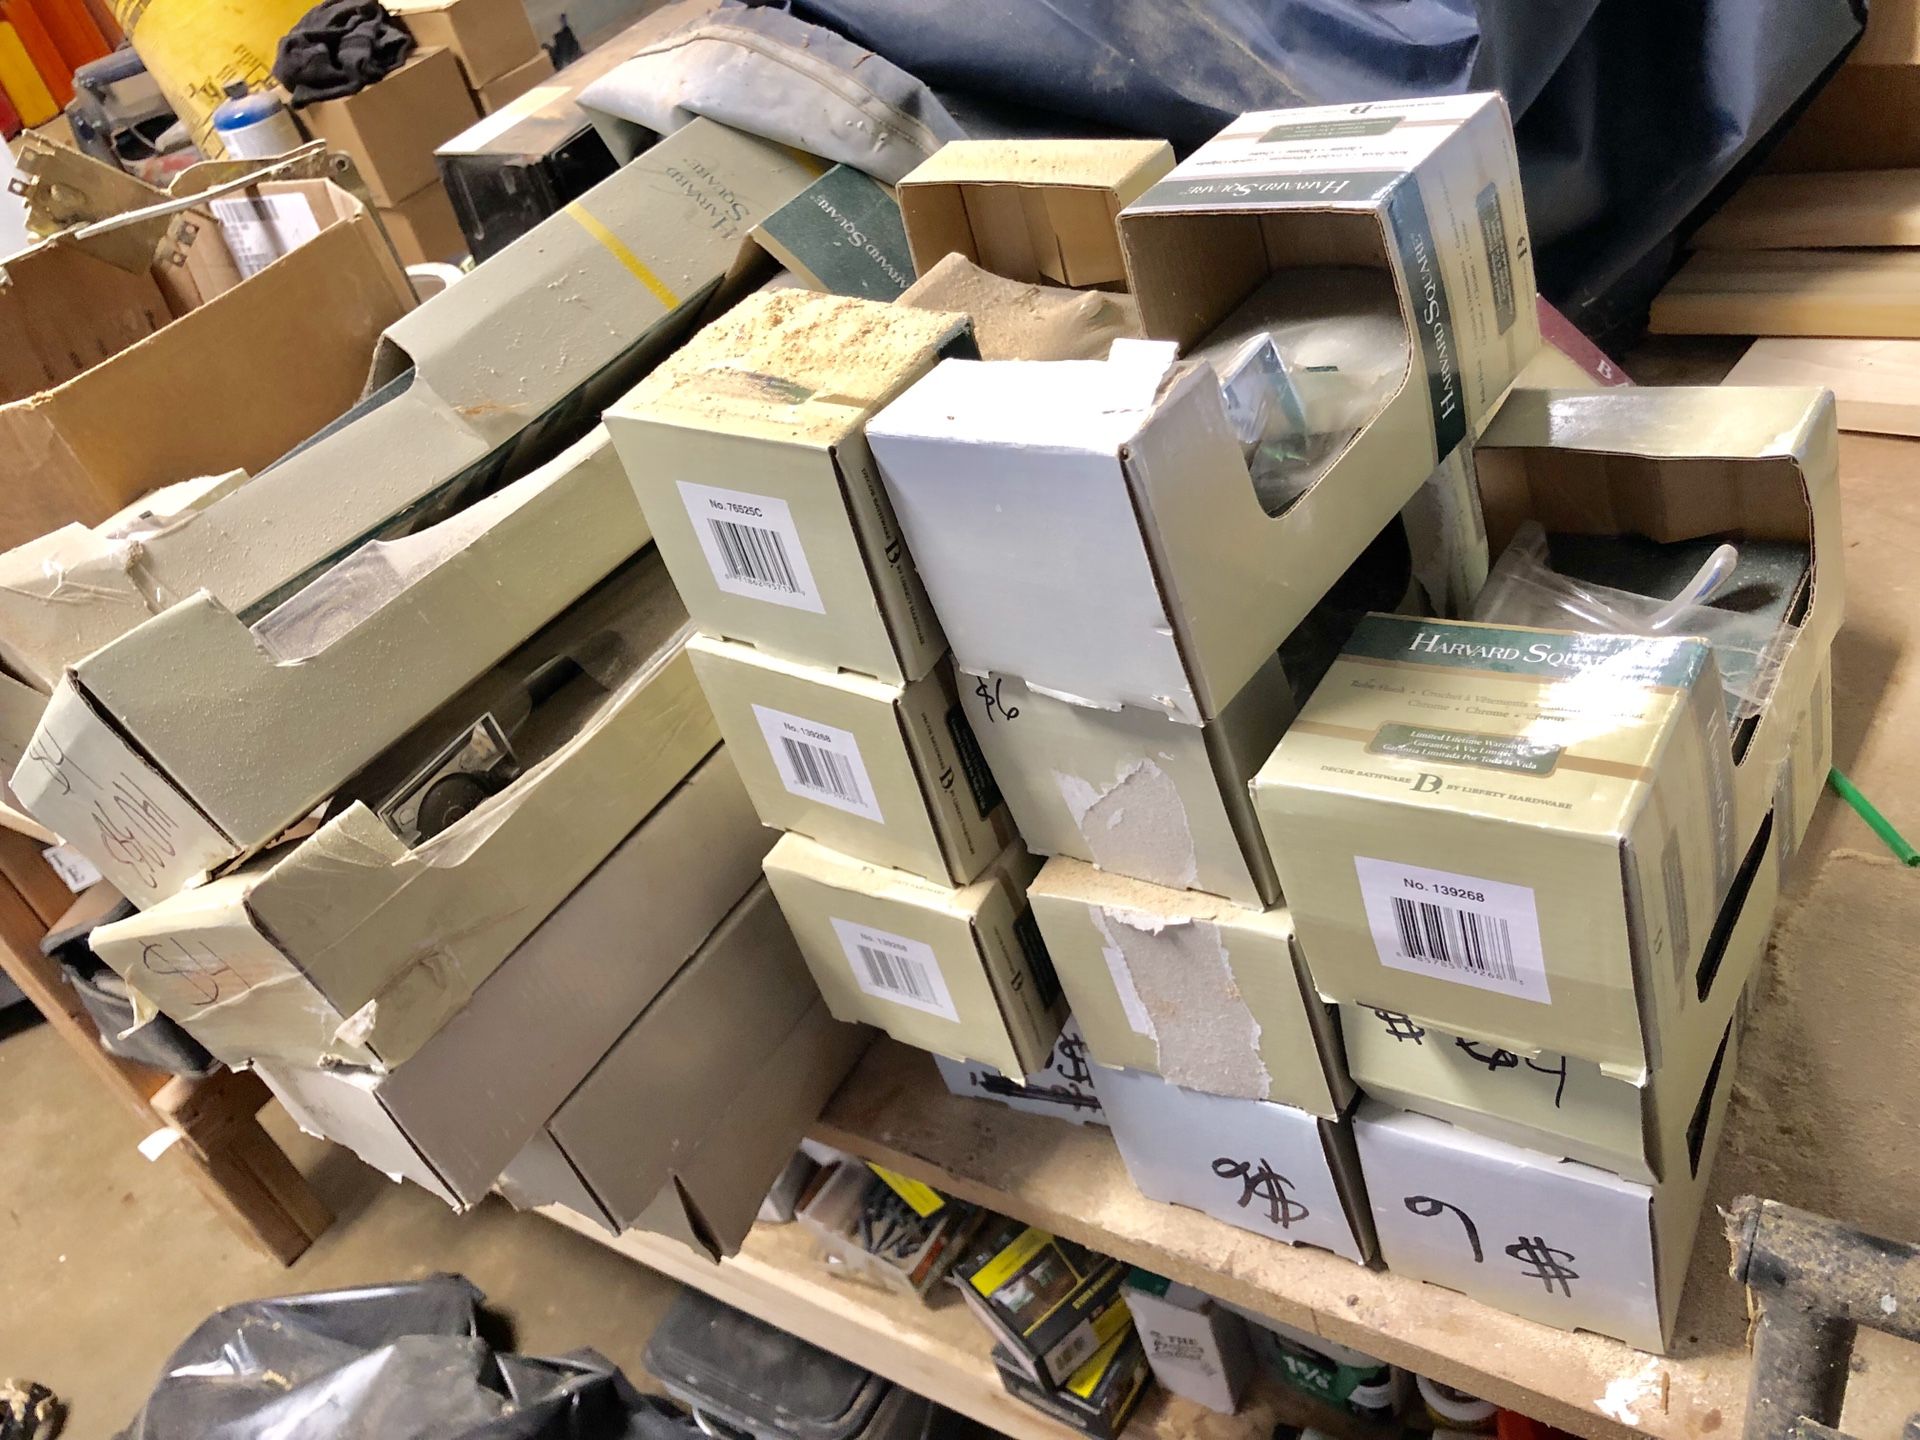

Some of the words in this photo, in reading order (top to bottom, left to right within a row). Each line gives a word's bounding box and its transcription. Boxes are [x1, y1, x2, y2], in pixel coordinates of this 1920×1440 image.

[666, 167, 738, 239] HARVARD
[687, 162, 750, 221] SQUARE
[1186, 183, 1257, 196] SQUARE
[1258, 180, 1350, 194] HARVARD
[815, 194, 867, 247] SQUARE
[865, 244, 911, 289] ARVARD
[1413, 234, 1440, 324] SQUARE
[1433, 322, 1455, 420] HARVARD
[1408, 632, 1520, 661] HARVARD
[975, 674, 1020, 723] $6
[1408, 699, 1449, 711] Chrome
[1465, 705, 1510, 718] Chrome
[1410, 730, 1444, 741] Limited
[1445, 734, 1482, 746] Lifetime
[1413, 739, 1450, 751] Garantie
[1463, 745, 1477, 753] Vie
[1421, 749, 1460, 760] Limitada
[1462, 753, 1477, 761] Por
[1515, 760, 1538, 770] Vida
[1320, 764, 1355, 776] DECOR
[1446, 783, 1461, 792] BY
[1461, 786, 1506, 799] LIBERTY
[1508, 793, 1573, 810] HARDWARE
[1403, 877, 1429, 892] No.
[1432, 883, 1485, 903] 139268
